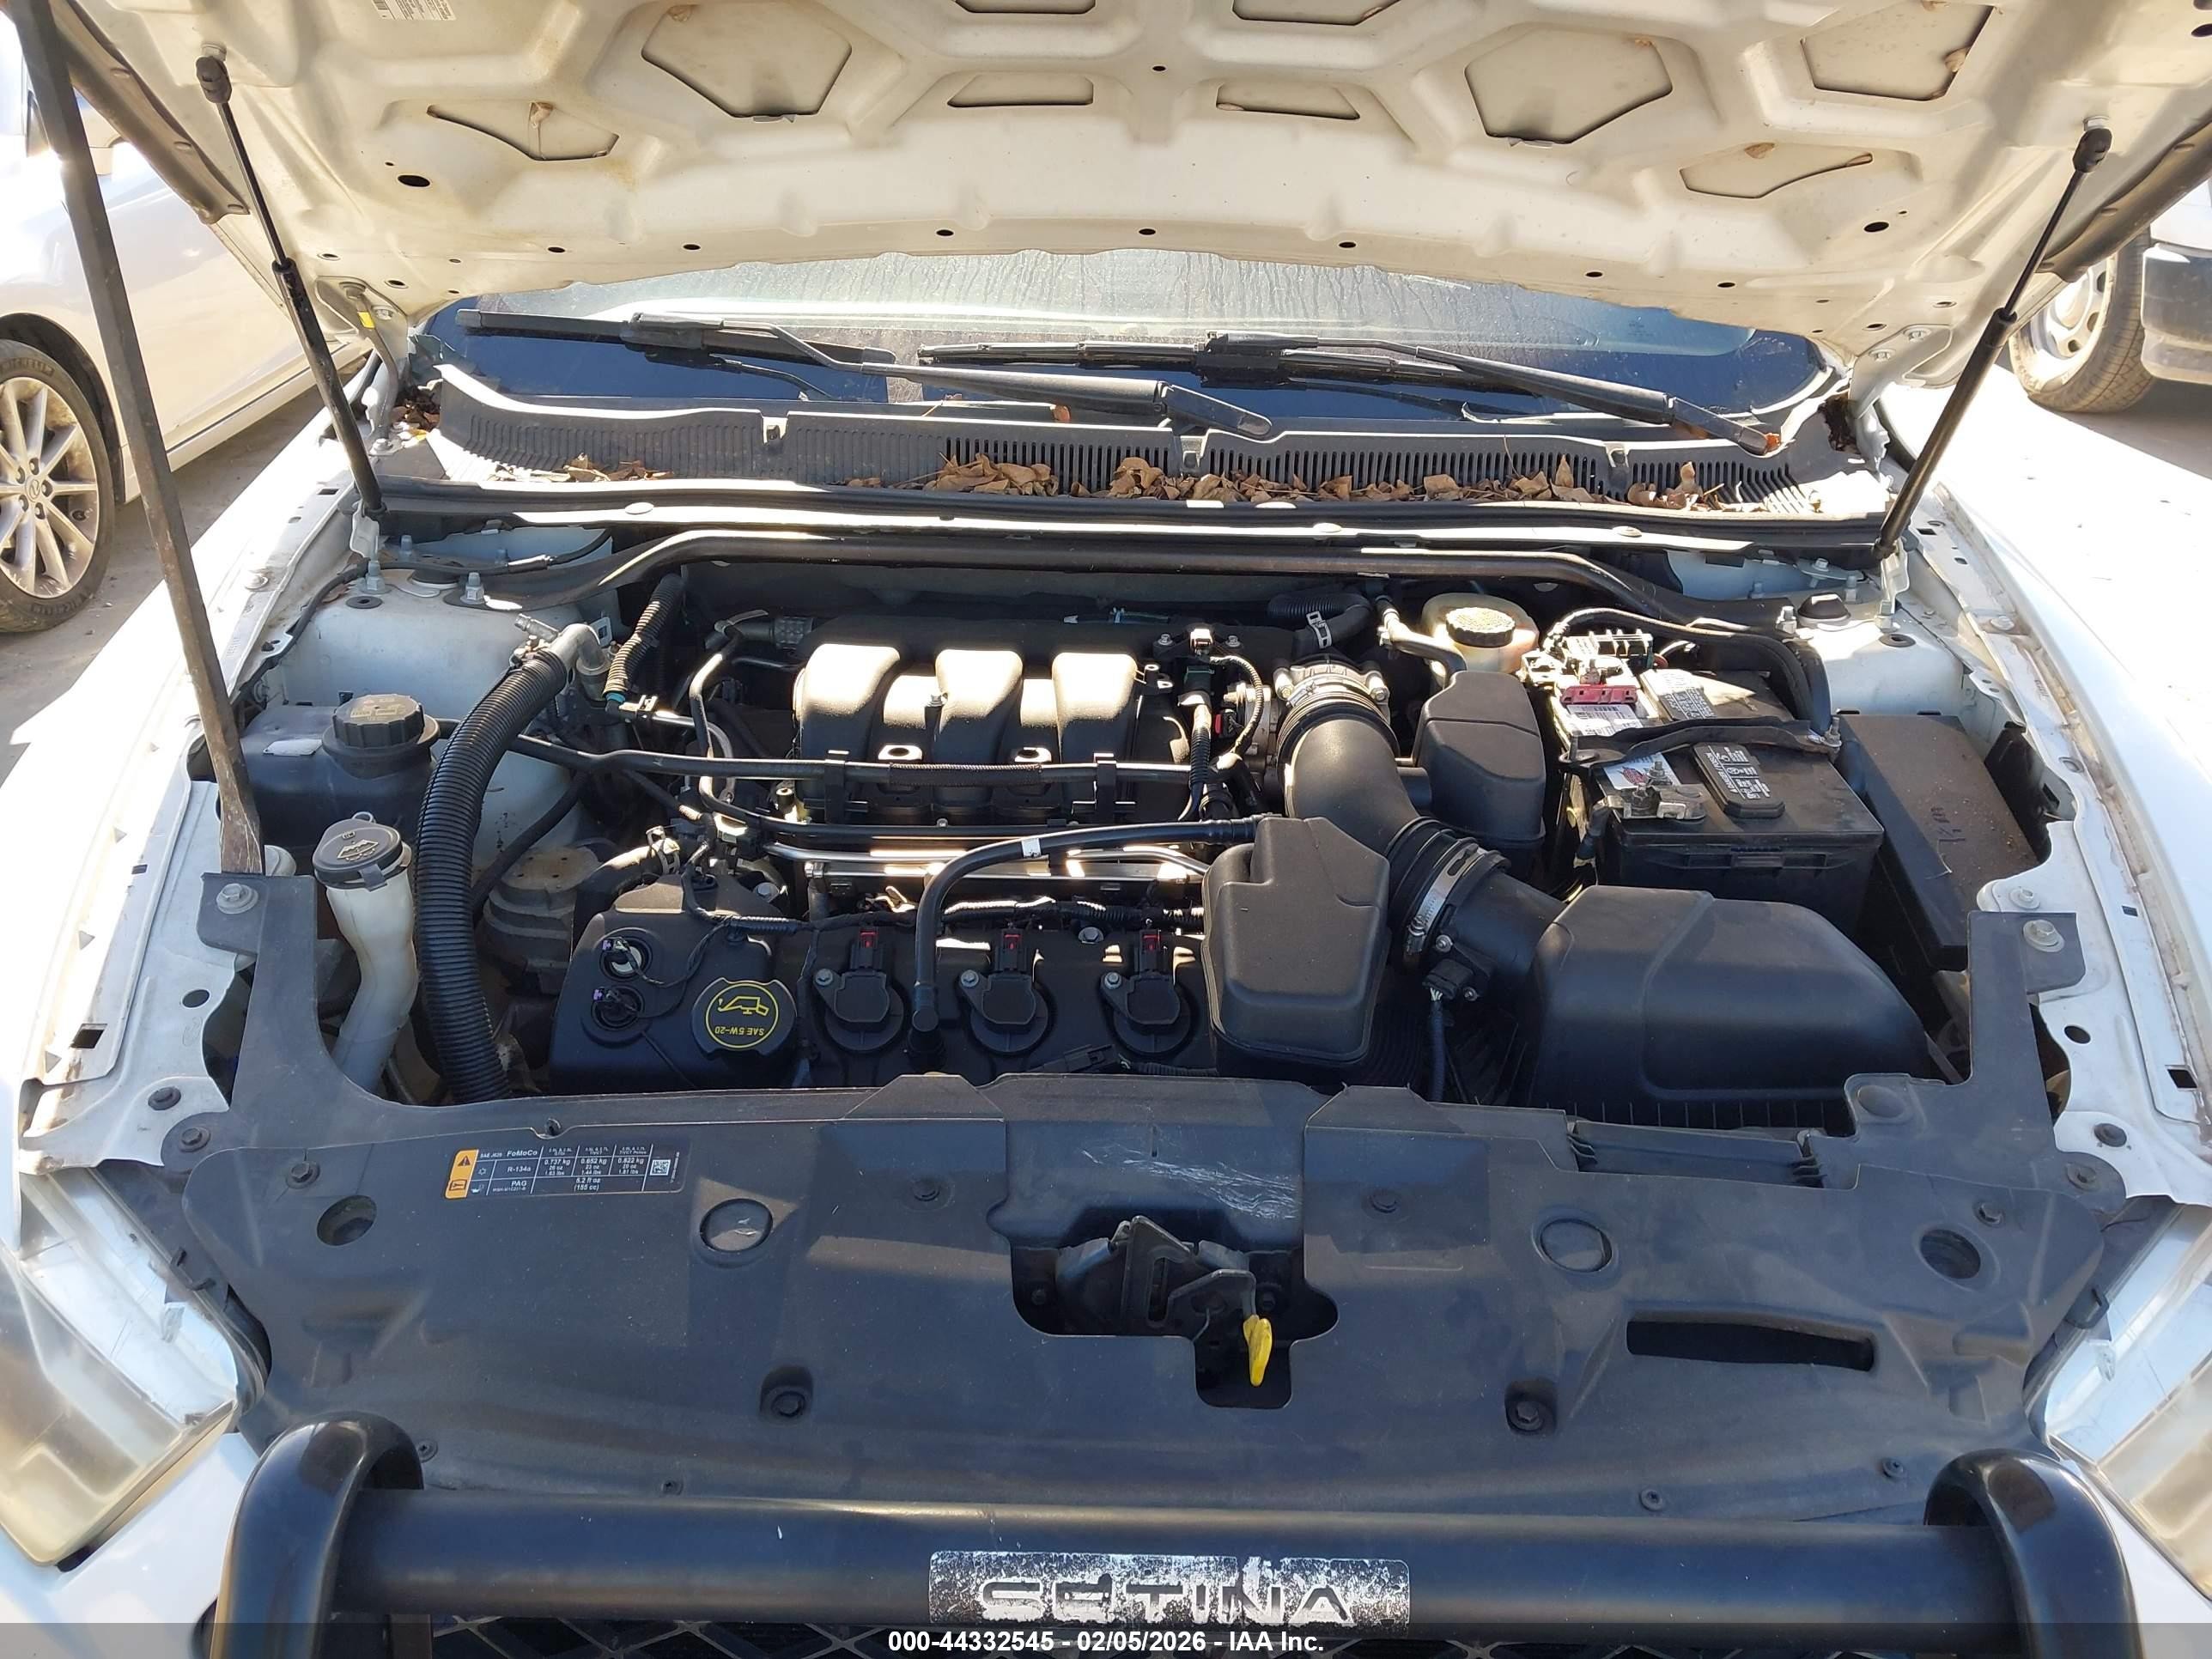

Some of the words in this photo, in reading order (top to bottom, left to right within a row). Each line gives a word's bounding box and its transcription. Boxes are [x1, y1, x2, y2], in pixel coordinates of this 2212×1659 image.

[714, 1026, 745, 1036] 5W-20
[746, 1028, 764, 1036] SAE
[507, 1149, 538, 1158] FoMoCo
